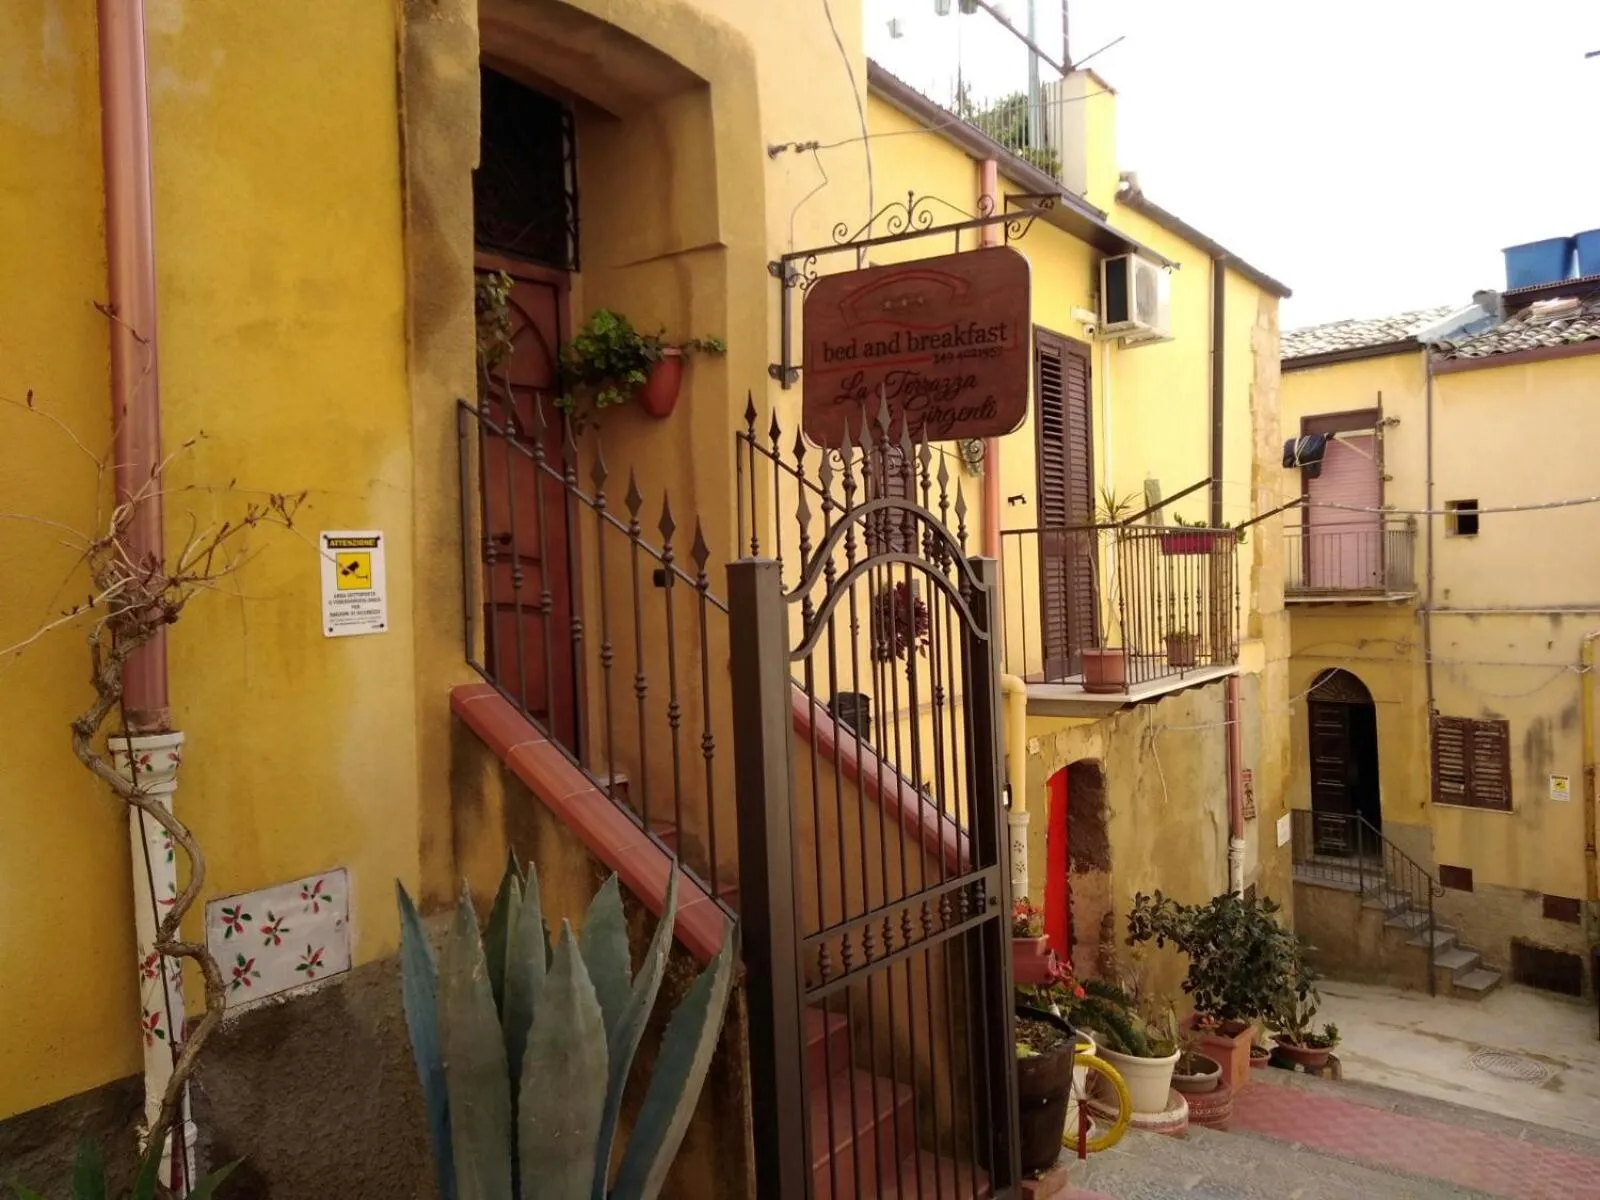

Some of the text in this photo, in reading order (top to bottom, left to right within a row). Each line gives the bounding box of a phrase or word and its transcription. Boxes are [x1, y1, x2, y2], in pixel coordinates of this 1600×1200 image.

[823, 322, 1007, 363] bed and breakfast
[833, 370, 869, 405] La
[902, 394, 998, 436] Girgenti
